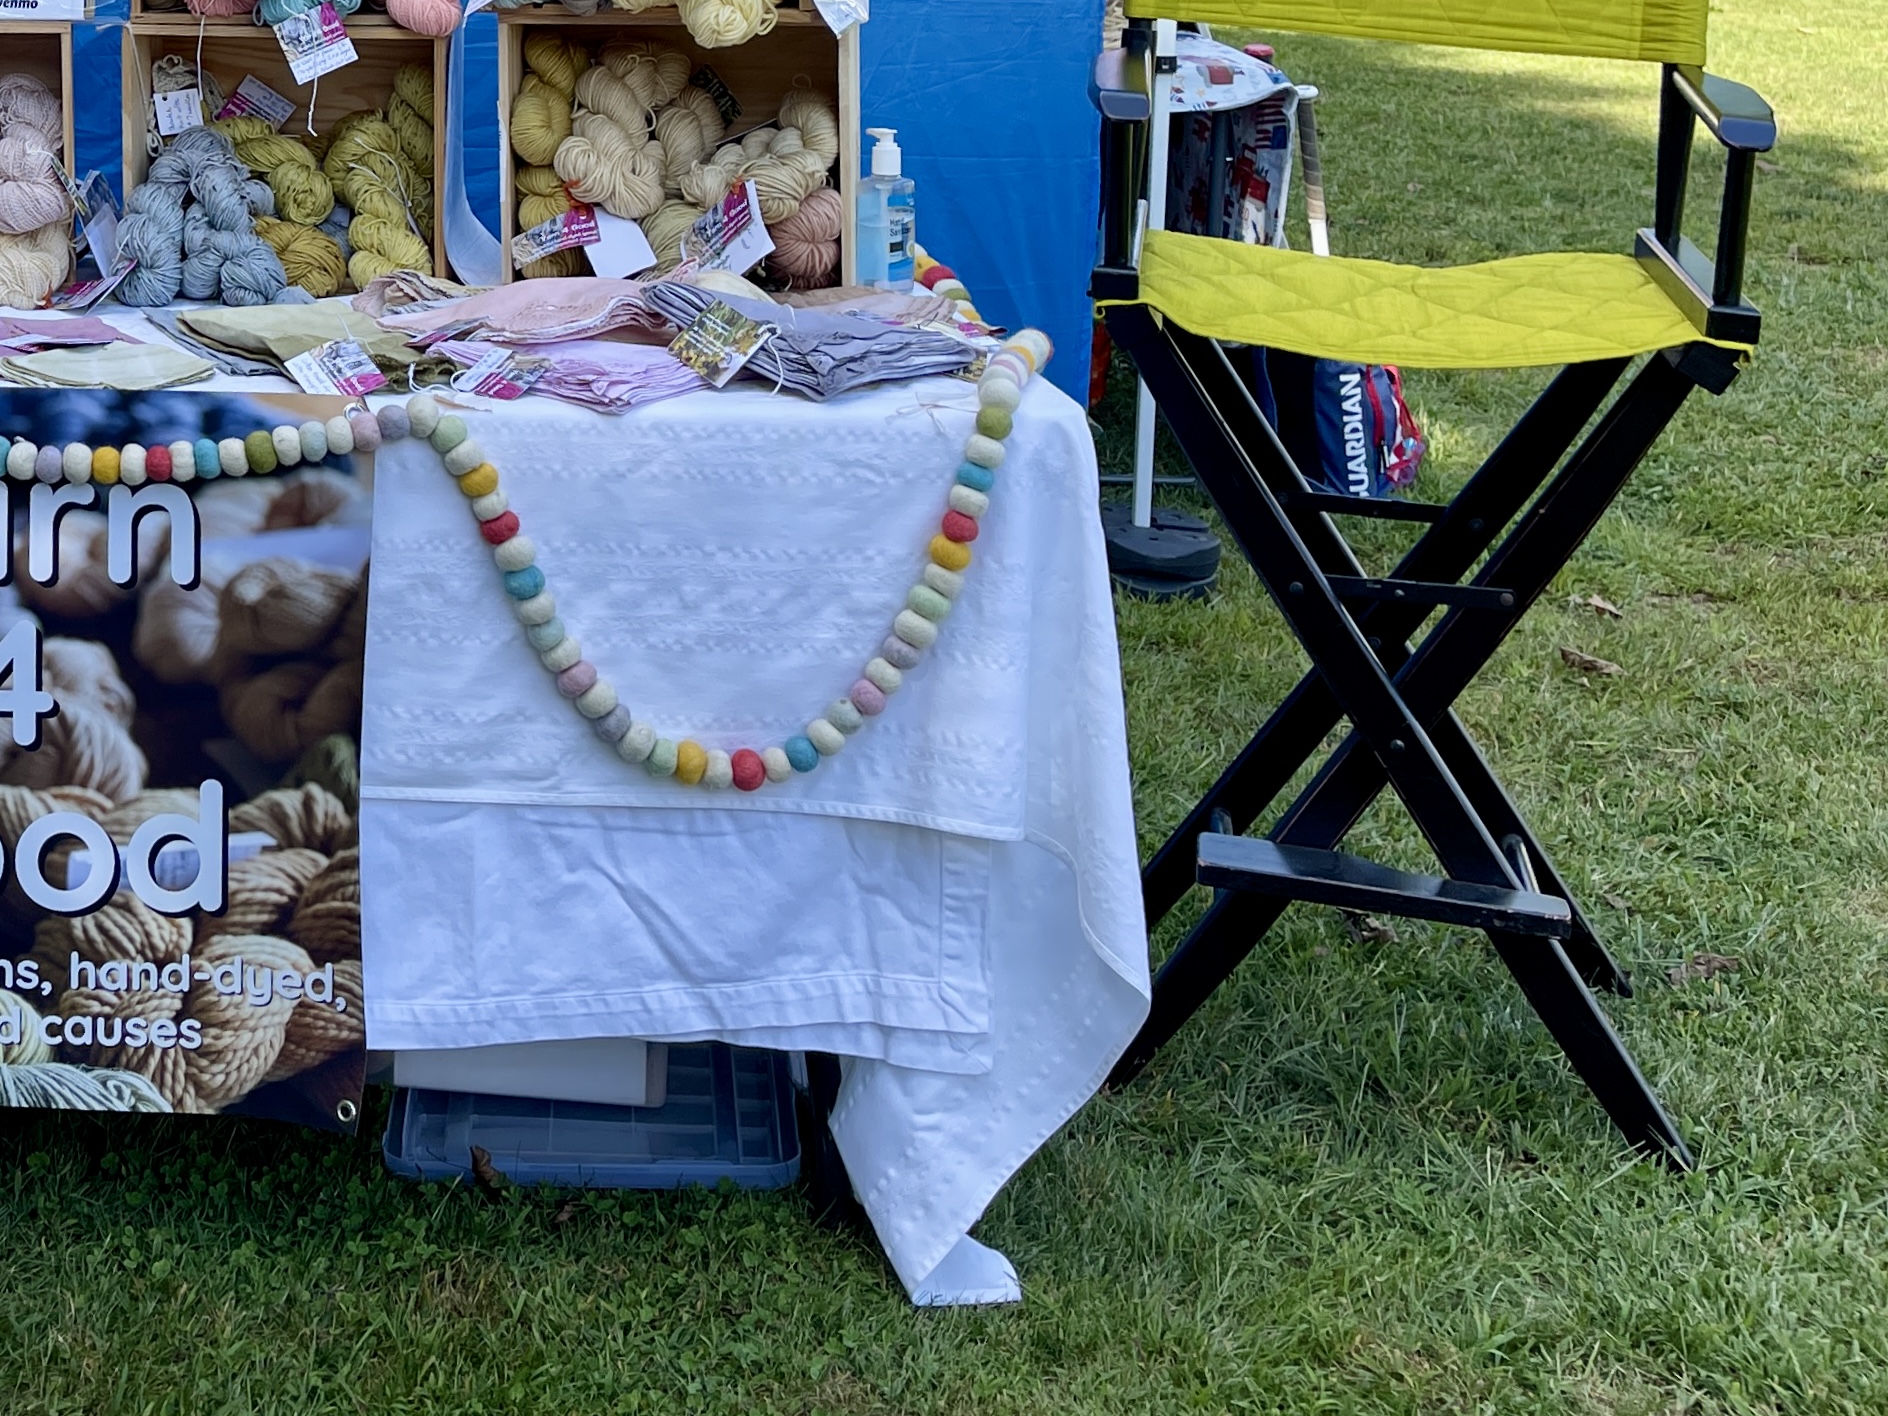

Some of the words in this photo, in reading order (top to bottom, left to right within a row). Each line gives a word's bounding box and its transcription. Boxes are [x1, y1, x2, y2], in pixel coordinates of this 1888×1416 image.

[571, 219, 596, 231] Good
[1339, 373, 1370, 497] UARDIAN
[68, 950, 349, 1014] hand-dyed,
[40, 1012, 205, 1051] causes
